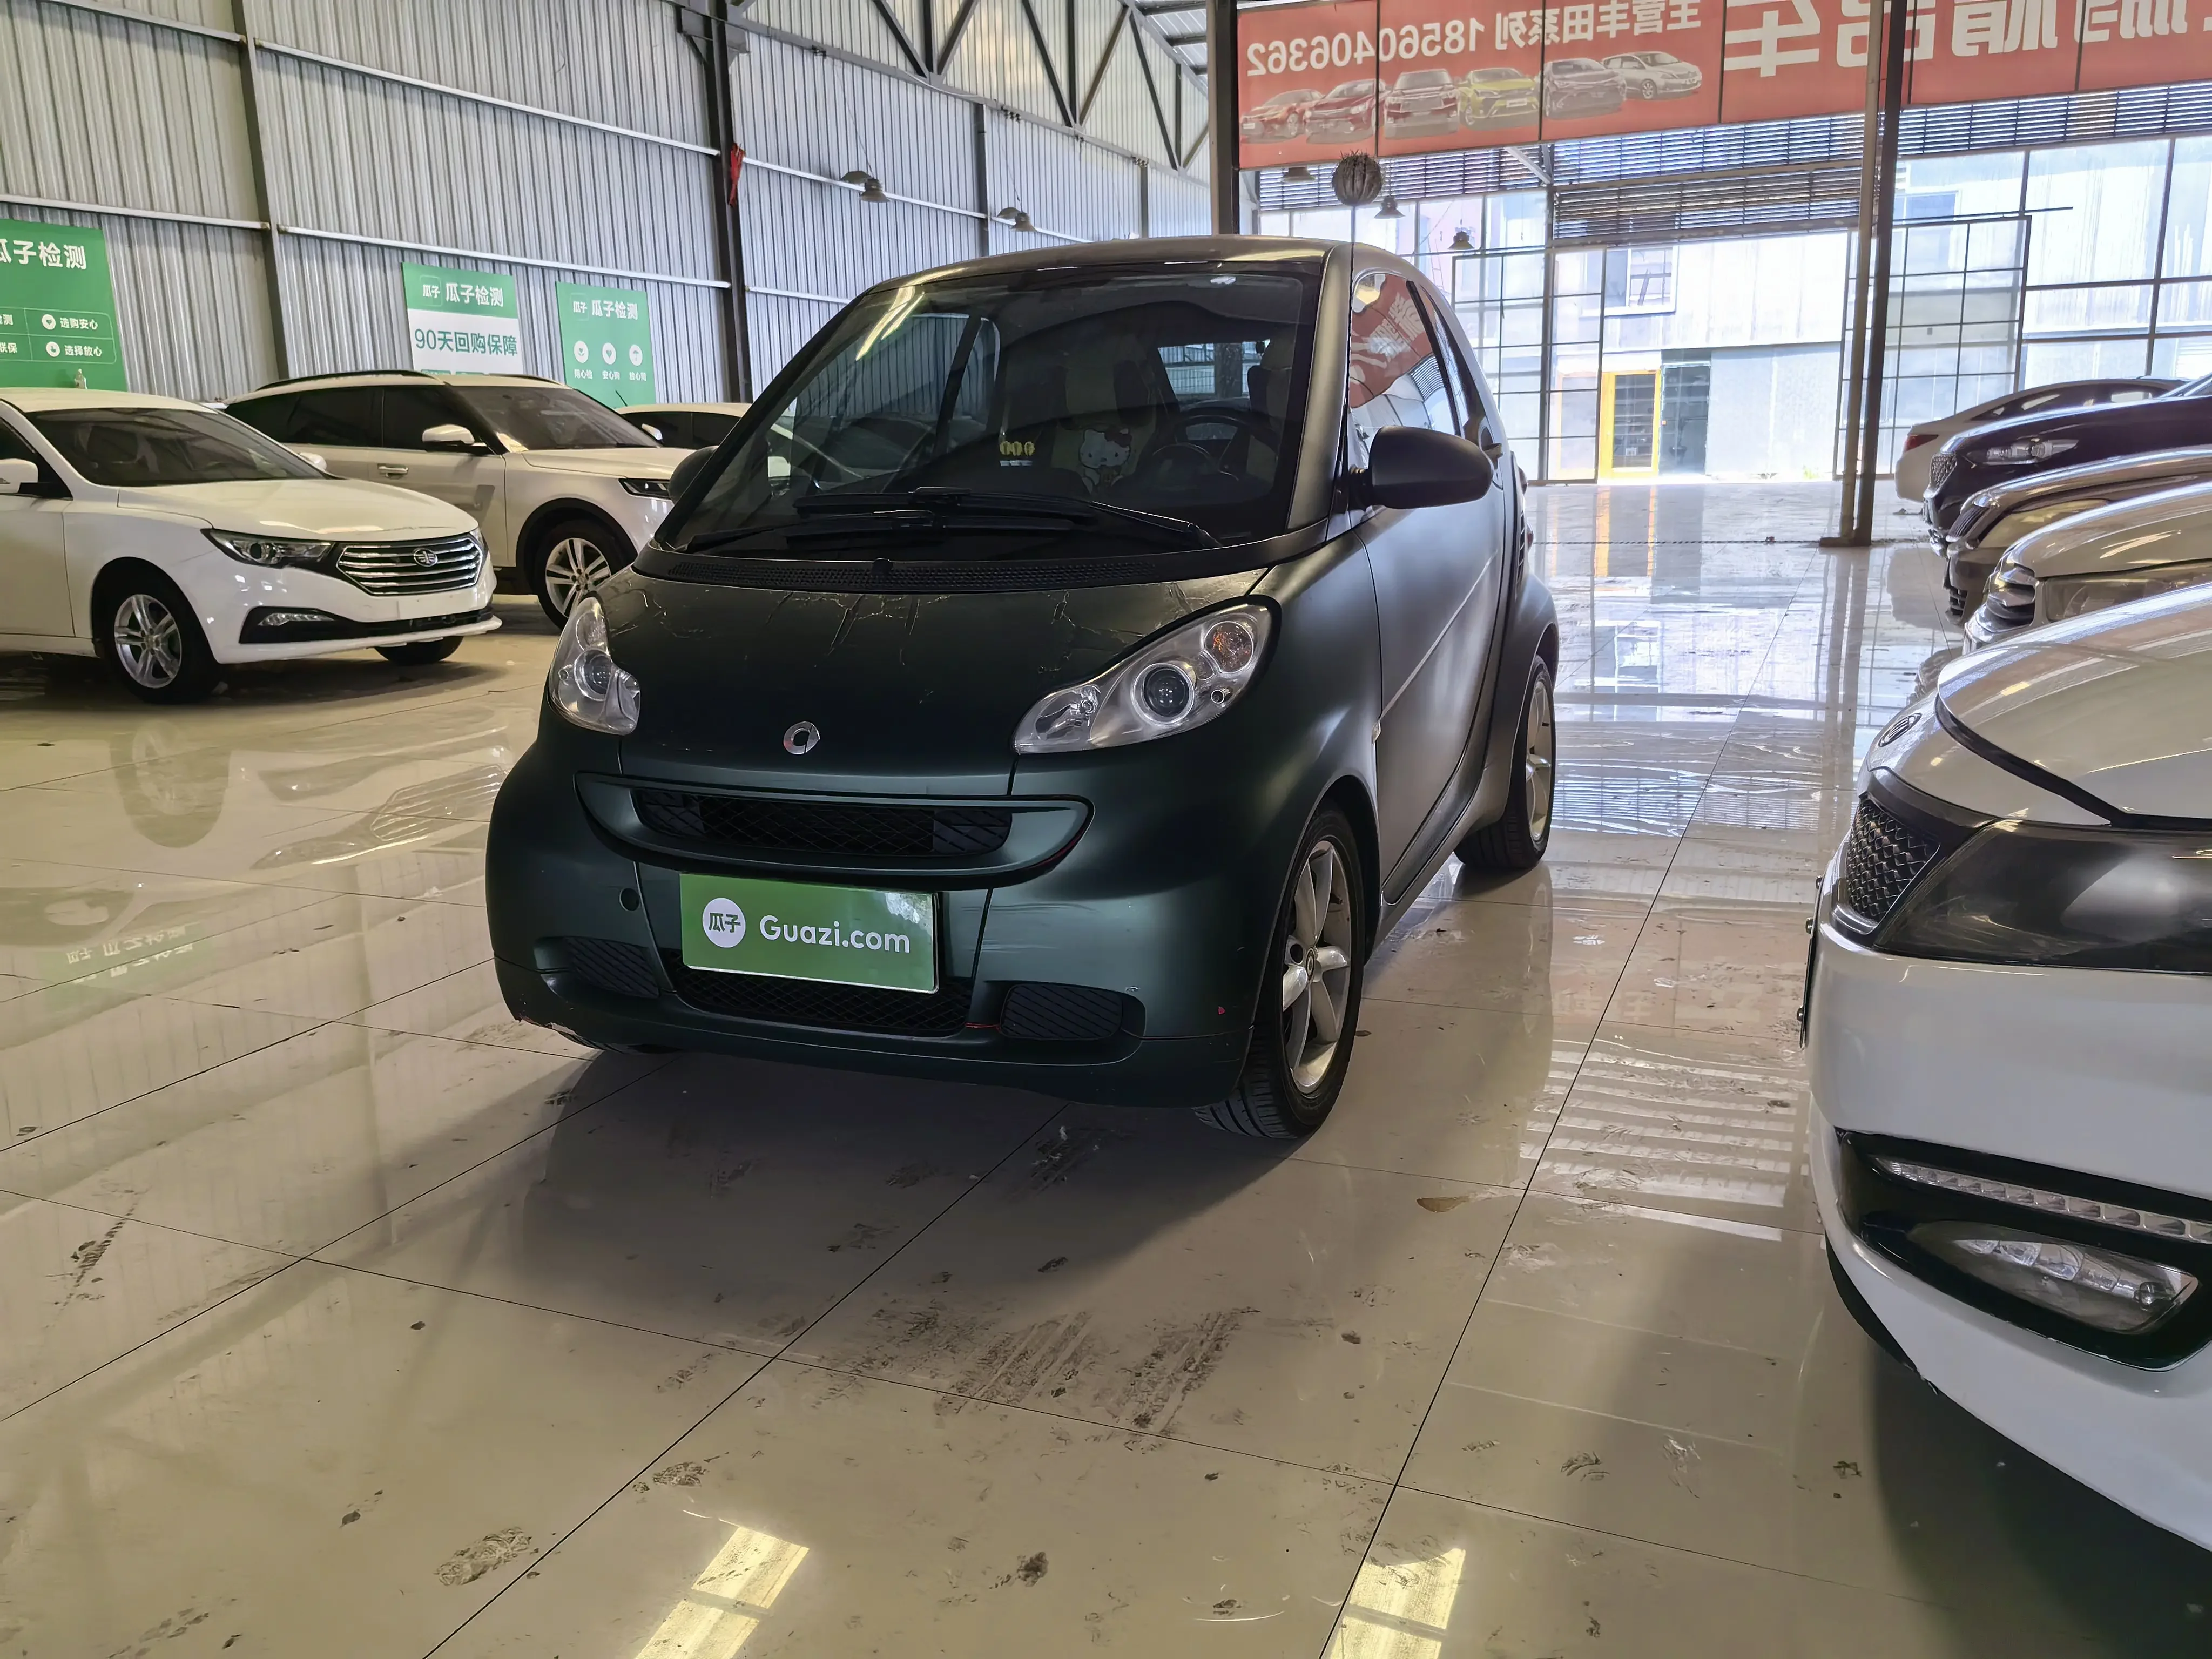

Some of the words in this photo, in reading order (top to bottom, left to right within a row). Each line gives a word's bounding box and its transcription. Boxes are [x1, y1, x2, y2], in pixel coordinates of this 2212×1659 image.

[423, 284, 440, 298] 瓜子
[446, 283, 504, 307] 瓜子检测
[592, 300, 638, 320] 瓜子检测
[414, 328, 518, 356] 90天回购保障
[708, 912, 741, 933] 瓜子
[759, 914, 911, 953] Guazi.com
